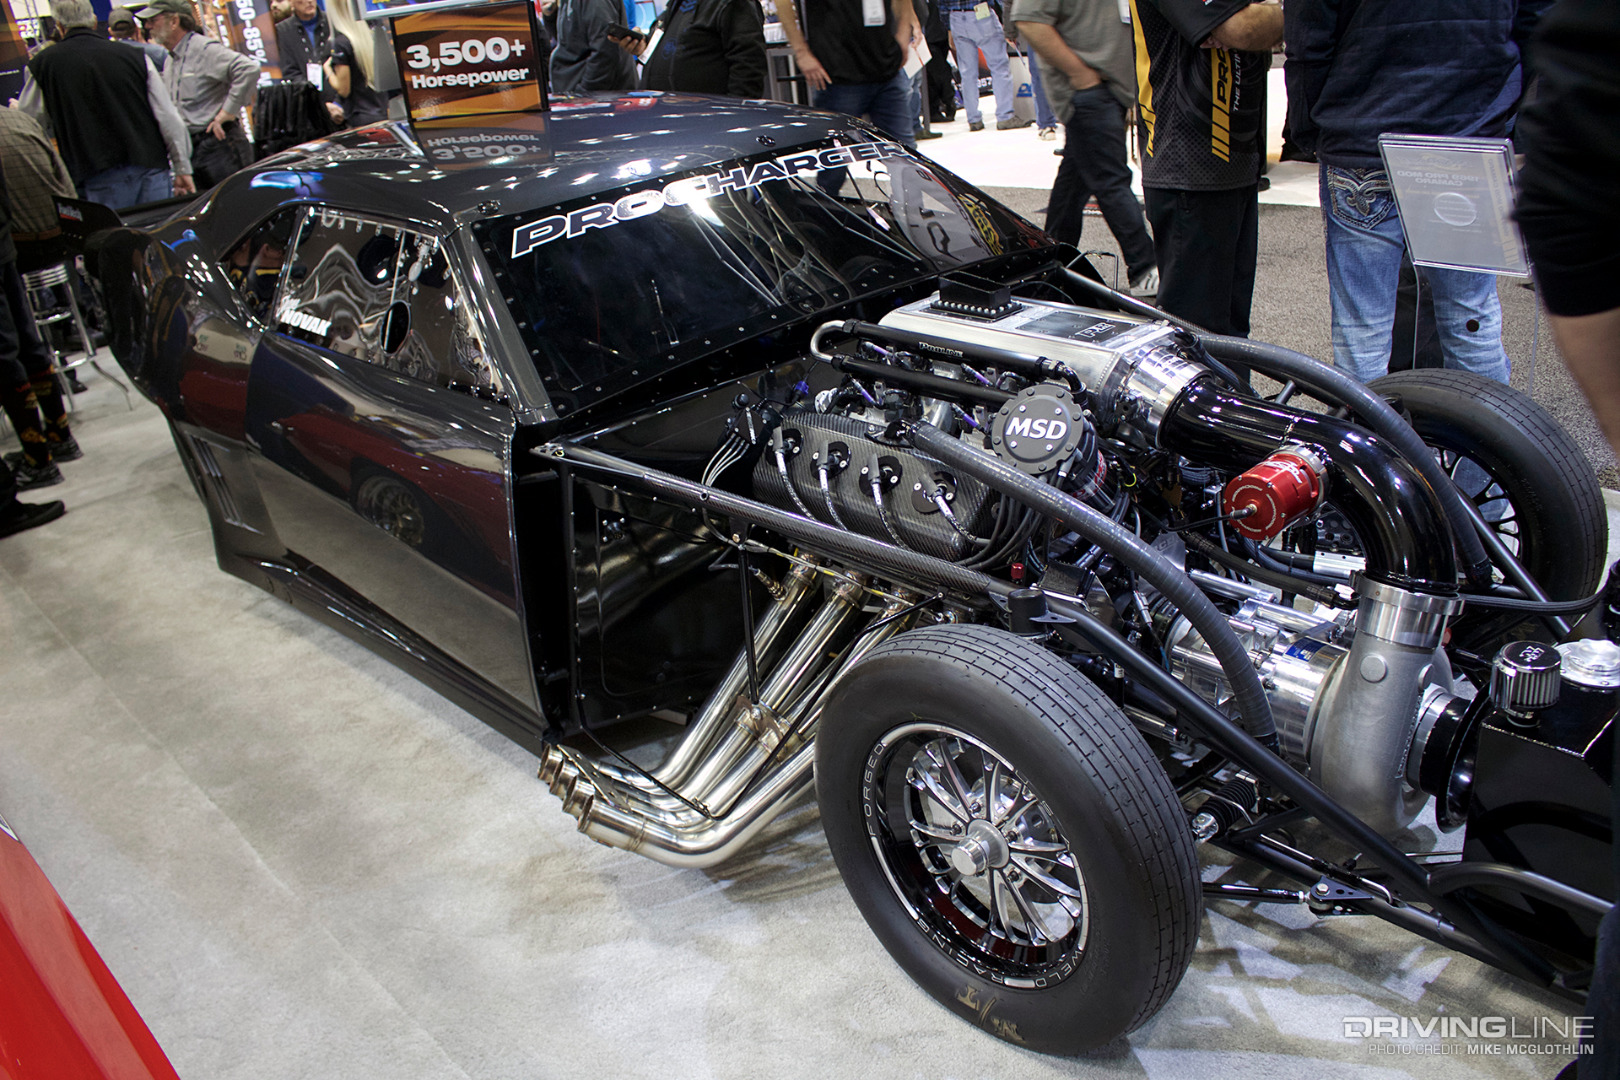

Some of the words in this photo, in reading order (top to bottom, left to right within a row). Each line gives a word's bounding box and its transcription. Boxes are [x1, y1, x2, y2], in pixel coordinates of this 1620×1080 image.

[406, 37, 526, 73] 3,500+
[411, 67, 530, 90] Horsepower
[1232, 88, 1241, 112] THE
[511, 141, 904, 259] PROCHARGER
[280, 308, 332, 337] NOVAK
[1005, 416, 1067, 440] MSD
[863, 743, 884, 836] FORGED
[916, 919, 1004, 984] RACING
[1034, 949, 1083, 988] WELD
